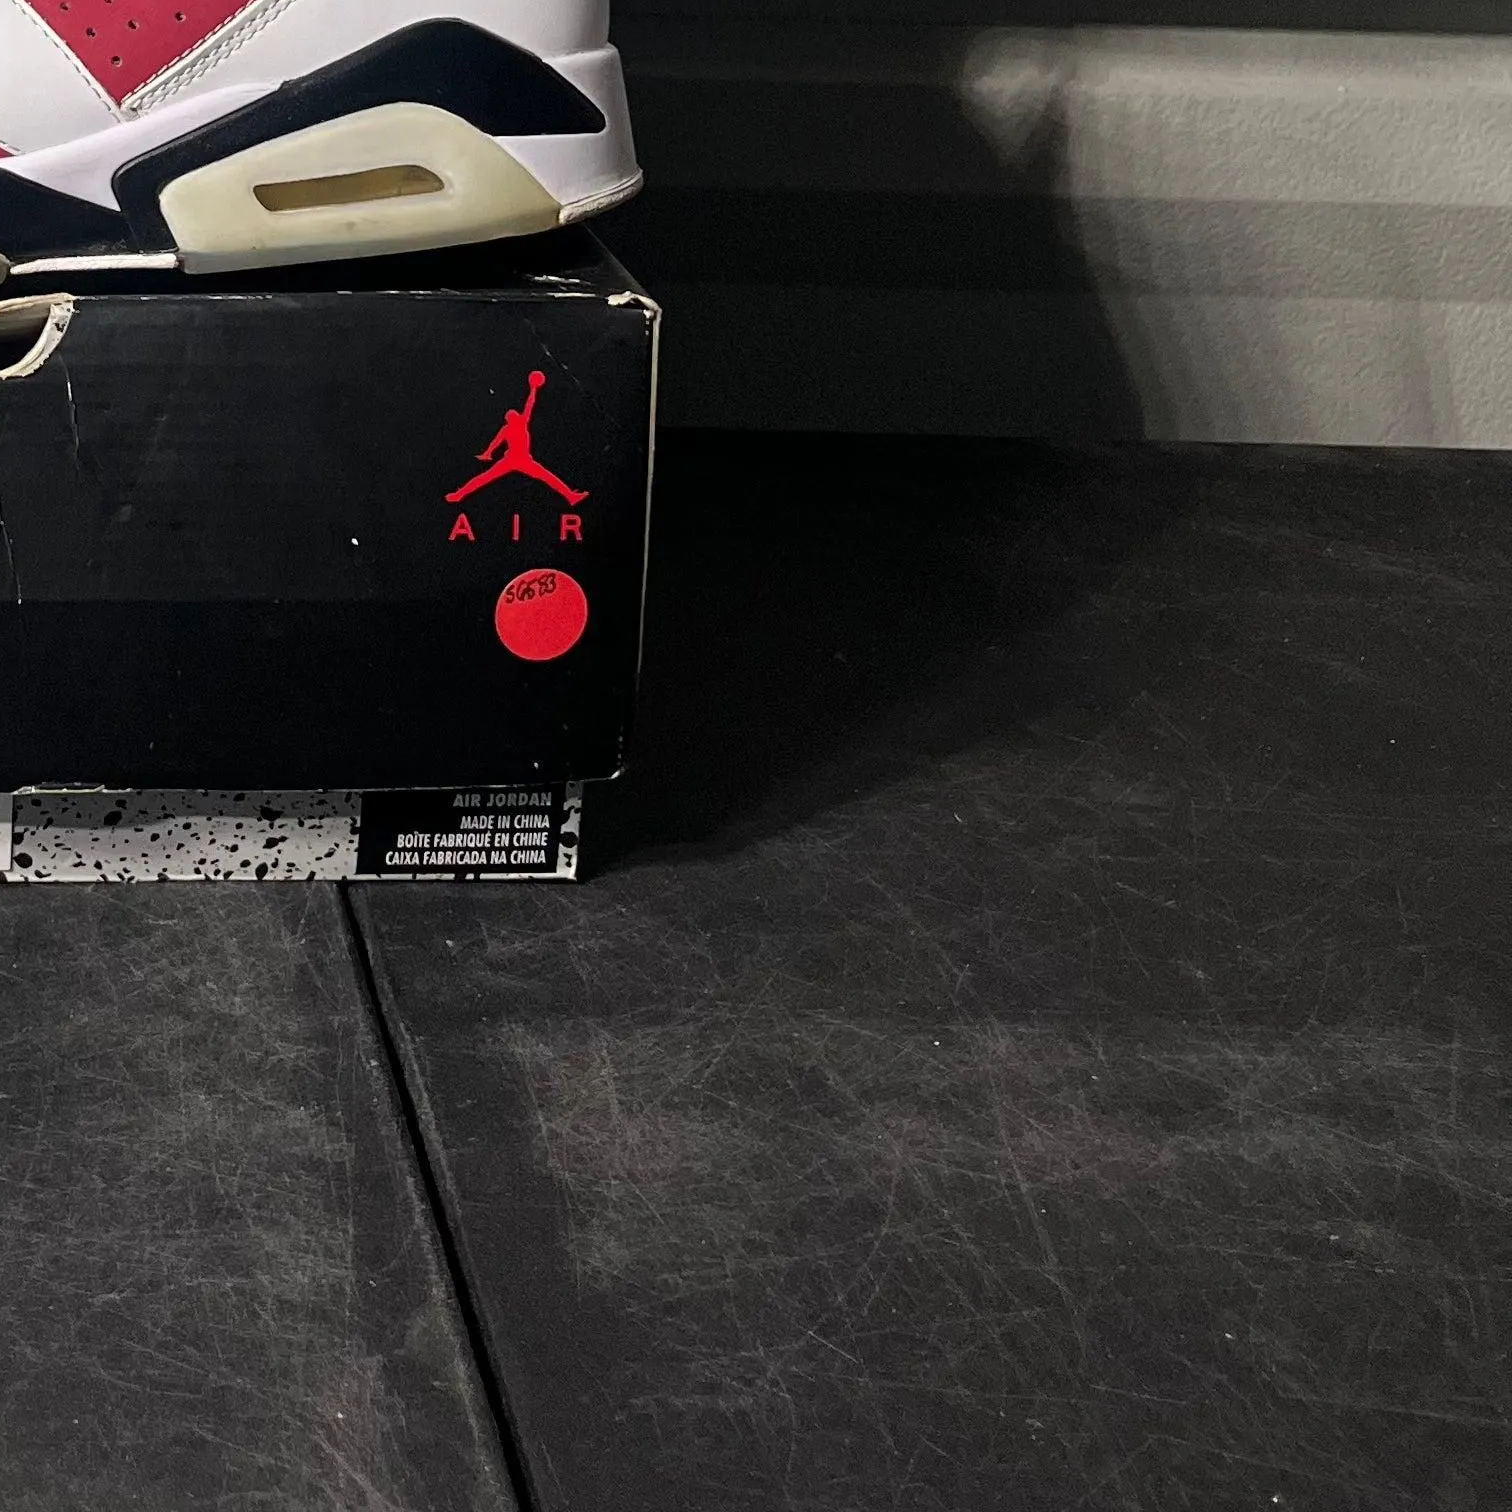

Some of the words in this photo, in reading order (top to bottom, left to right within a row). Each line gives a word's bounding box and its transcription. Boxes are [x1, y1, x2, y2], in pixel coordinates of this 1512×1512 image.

[448, 512, 583, 541] AIR
[453, 793, 481, 808] AIR
[486, 791, 553, 807] JORDAN
[460, 814, 495, 830] MADE
[498, 814, 511, 829] IN
[513, 814, 550, 829] CHINA
[397, 831, 431, 848] BOÎTE
[494, 832, 509, 847] EN
[513, 831, 549, 847] CHINE
[385, 851, 420, 866] CAIXA
[422, 850, 488, 865] FABRICADA
[490, 850, 507, 865] NA
[510, 849, 547, 864] CHINA
